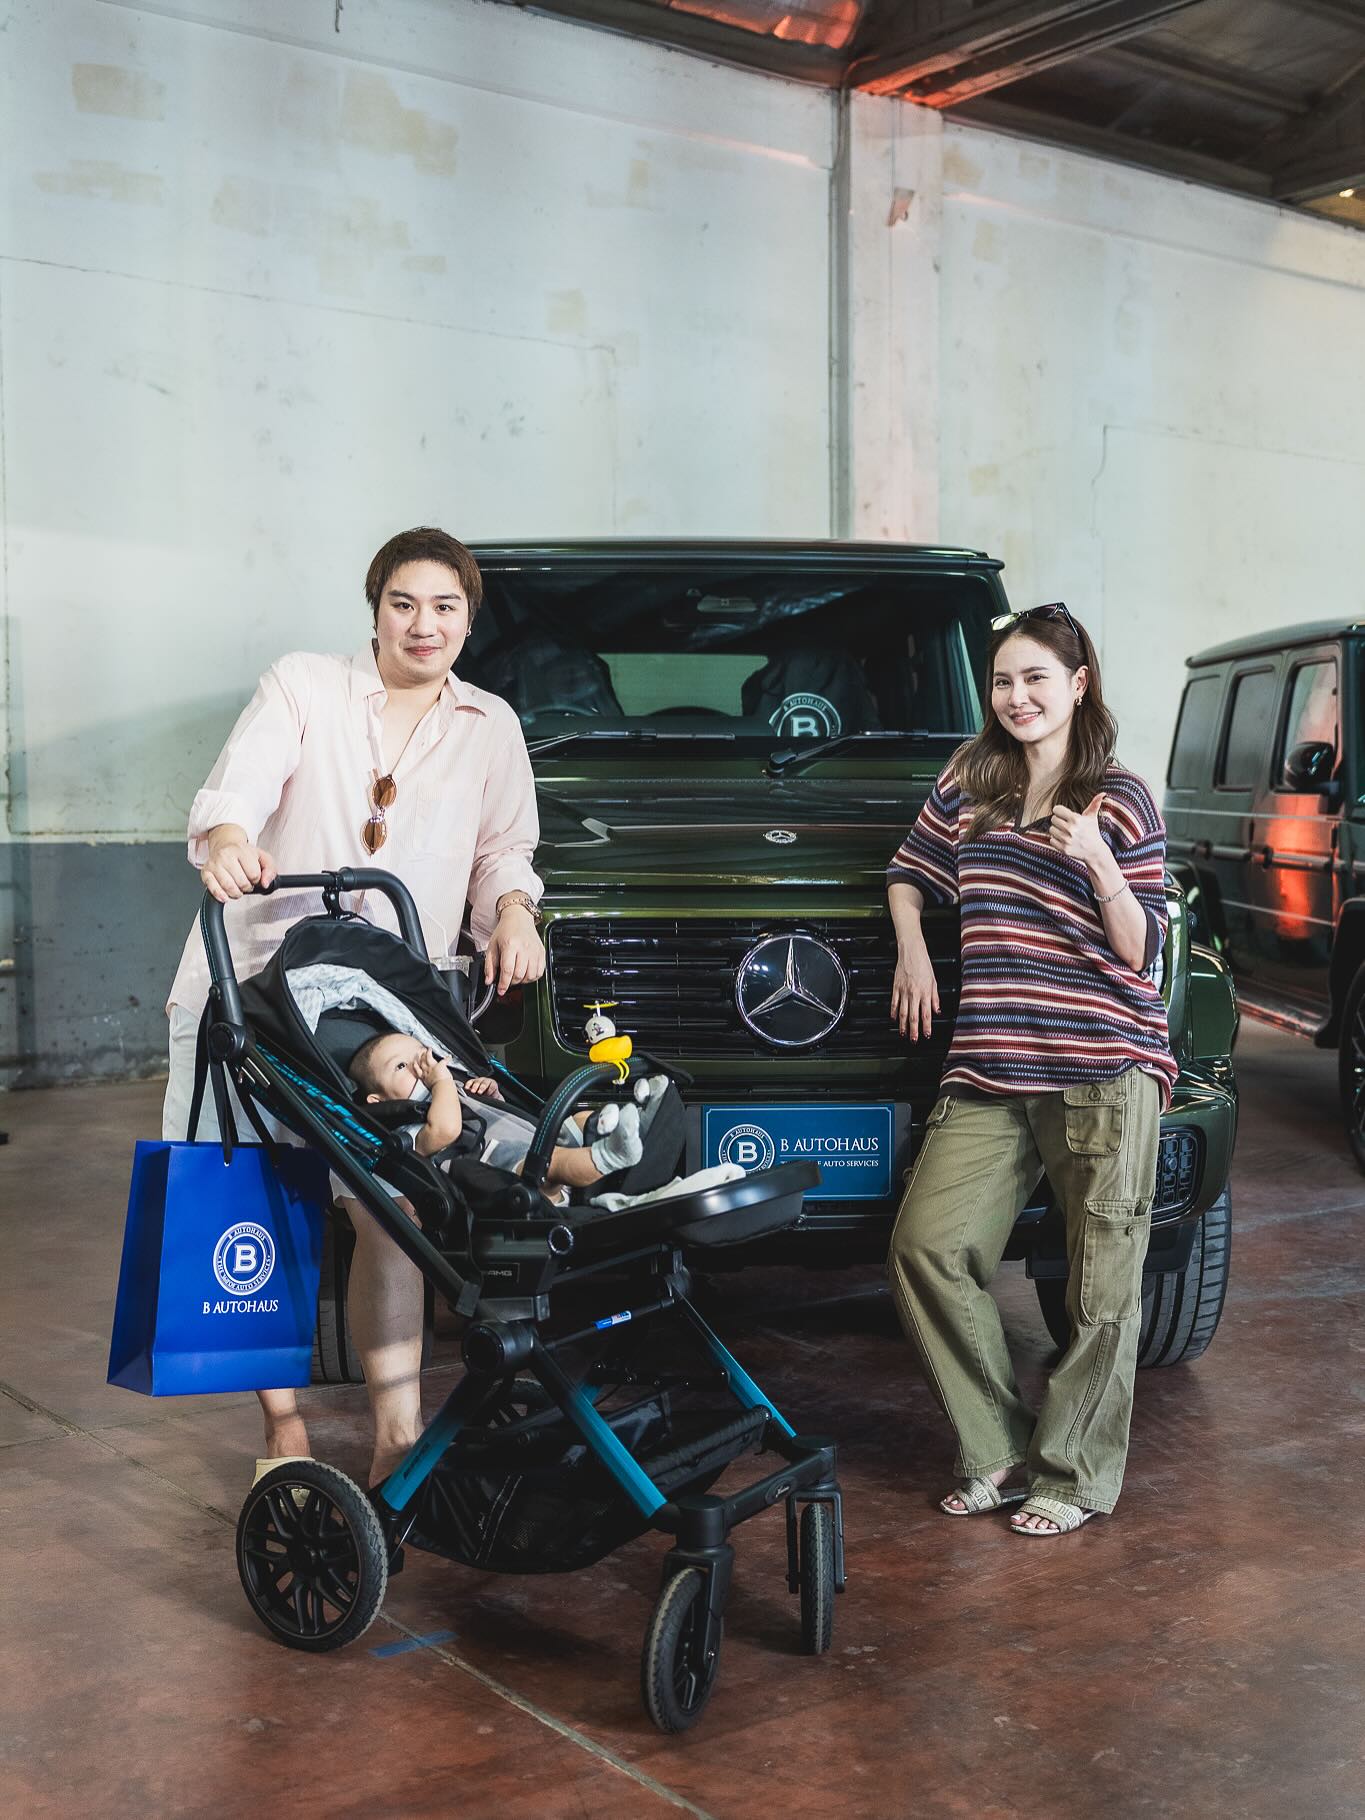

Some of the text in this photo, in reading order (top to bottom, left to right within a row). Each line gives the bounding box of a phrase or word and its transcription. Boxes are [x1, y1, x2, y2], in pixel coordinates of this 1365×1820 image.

[789, 696, 827, 711] AUTOHAUS
[735, 1127, 765, 1139] AUTOHAUS
[737, 1141, 758, 1163] B
[780, 1137, 879, 1152] B AUTOHAUS
[233, 1226, 266, 1241] AUTOHAUS
[233, 1243, 257, 1273] B
[202, 1299, 279, 1314] B AUTOHAUS
